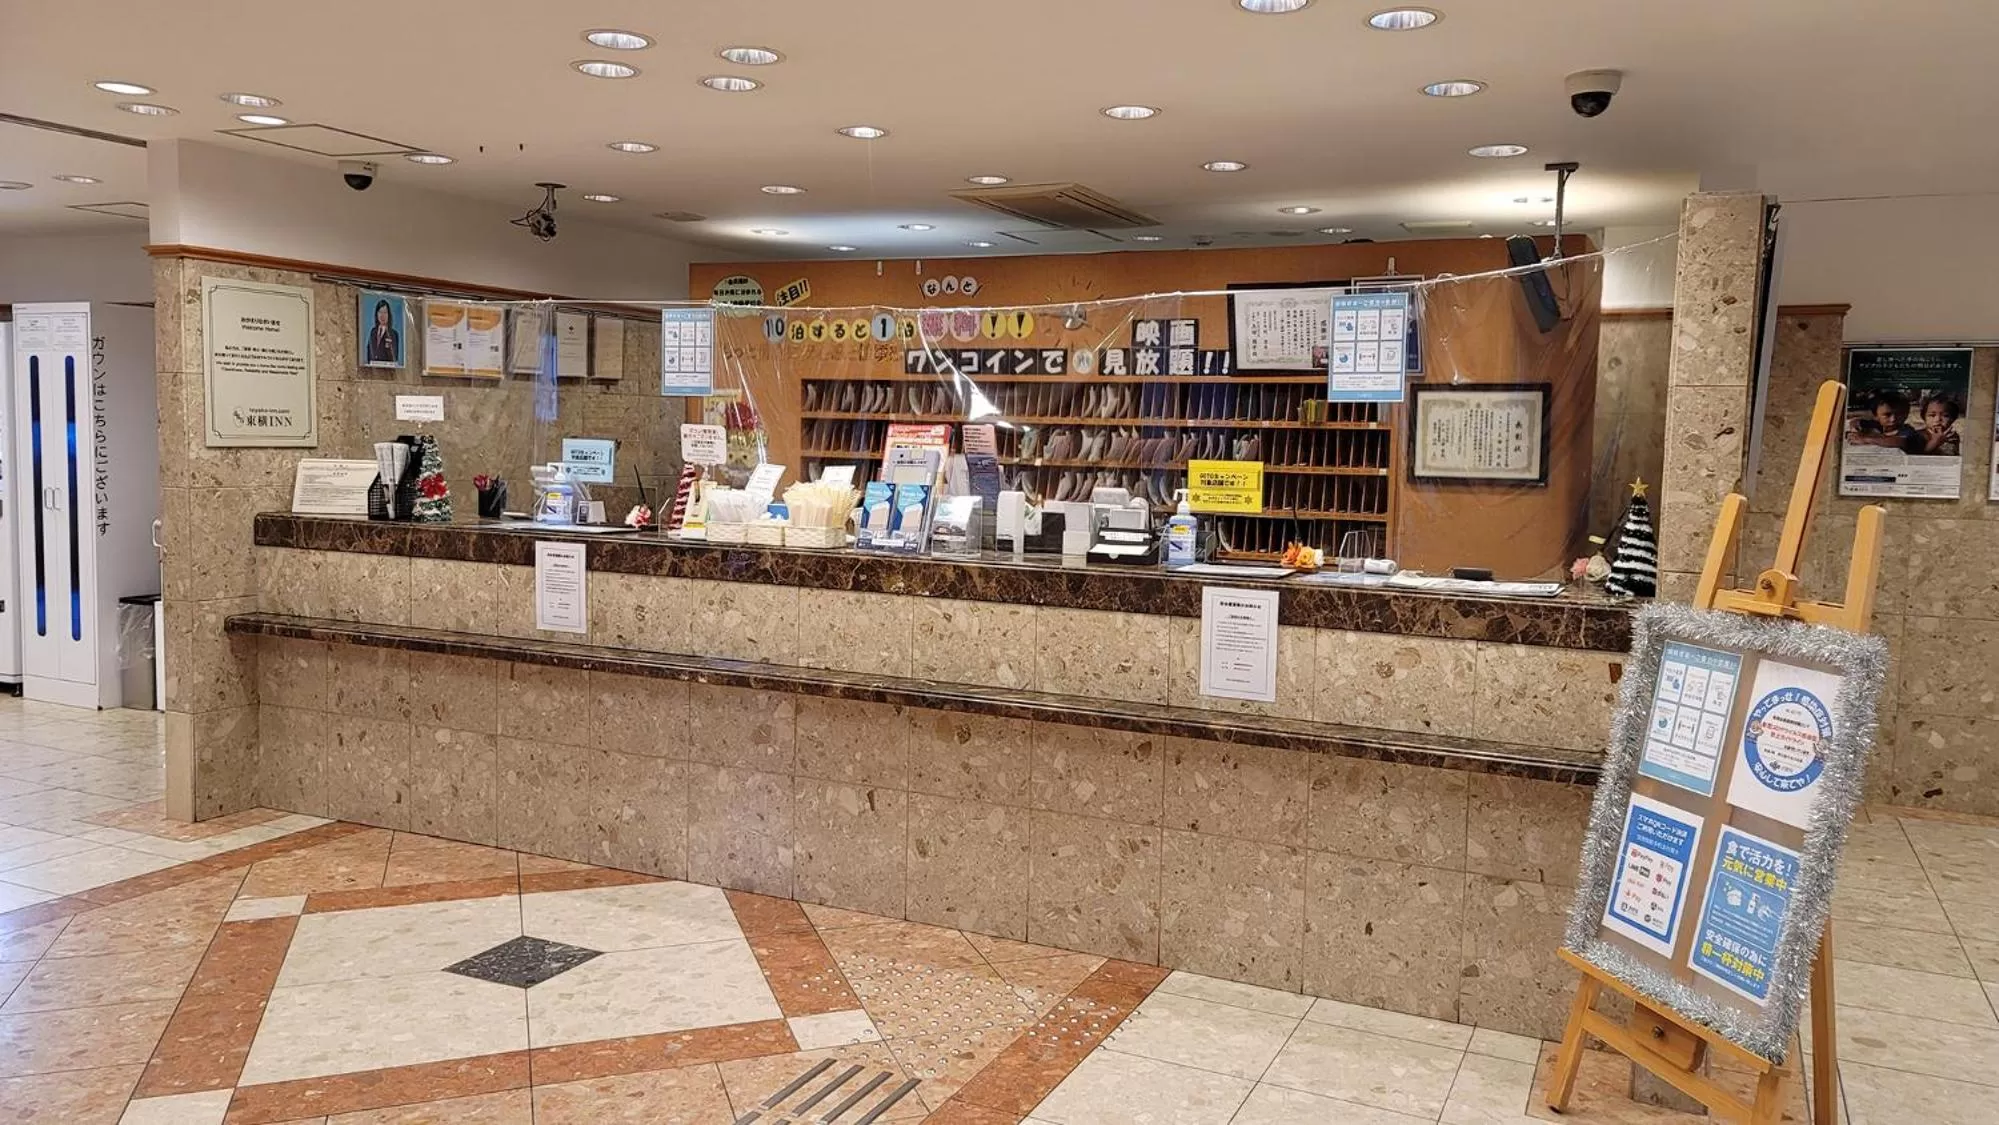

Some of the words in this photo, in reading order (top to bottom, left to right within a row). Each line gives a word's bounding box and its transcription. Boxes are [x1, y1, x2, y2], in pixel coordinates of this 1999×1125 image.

[926, 280, 973, 295] なんと
[1135, 320, 1195, 346] 映画
[907, 349, 1065, 375] ワンコインで
[246, 415, 293, 427] 東横INN
[1722, 856, 1788, 891] 元気に営業中
